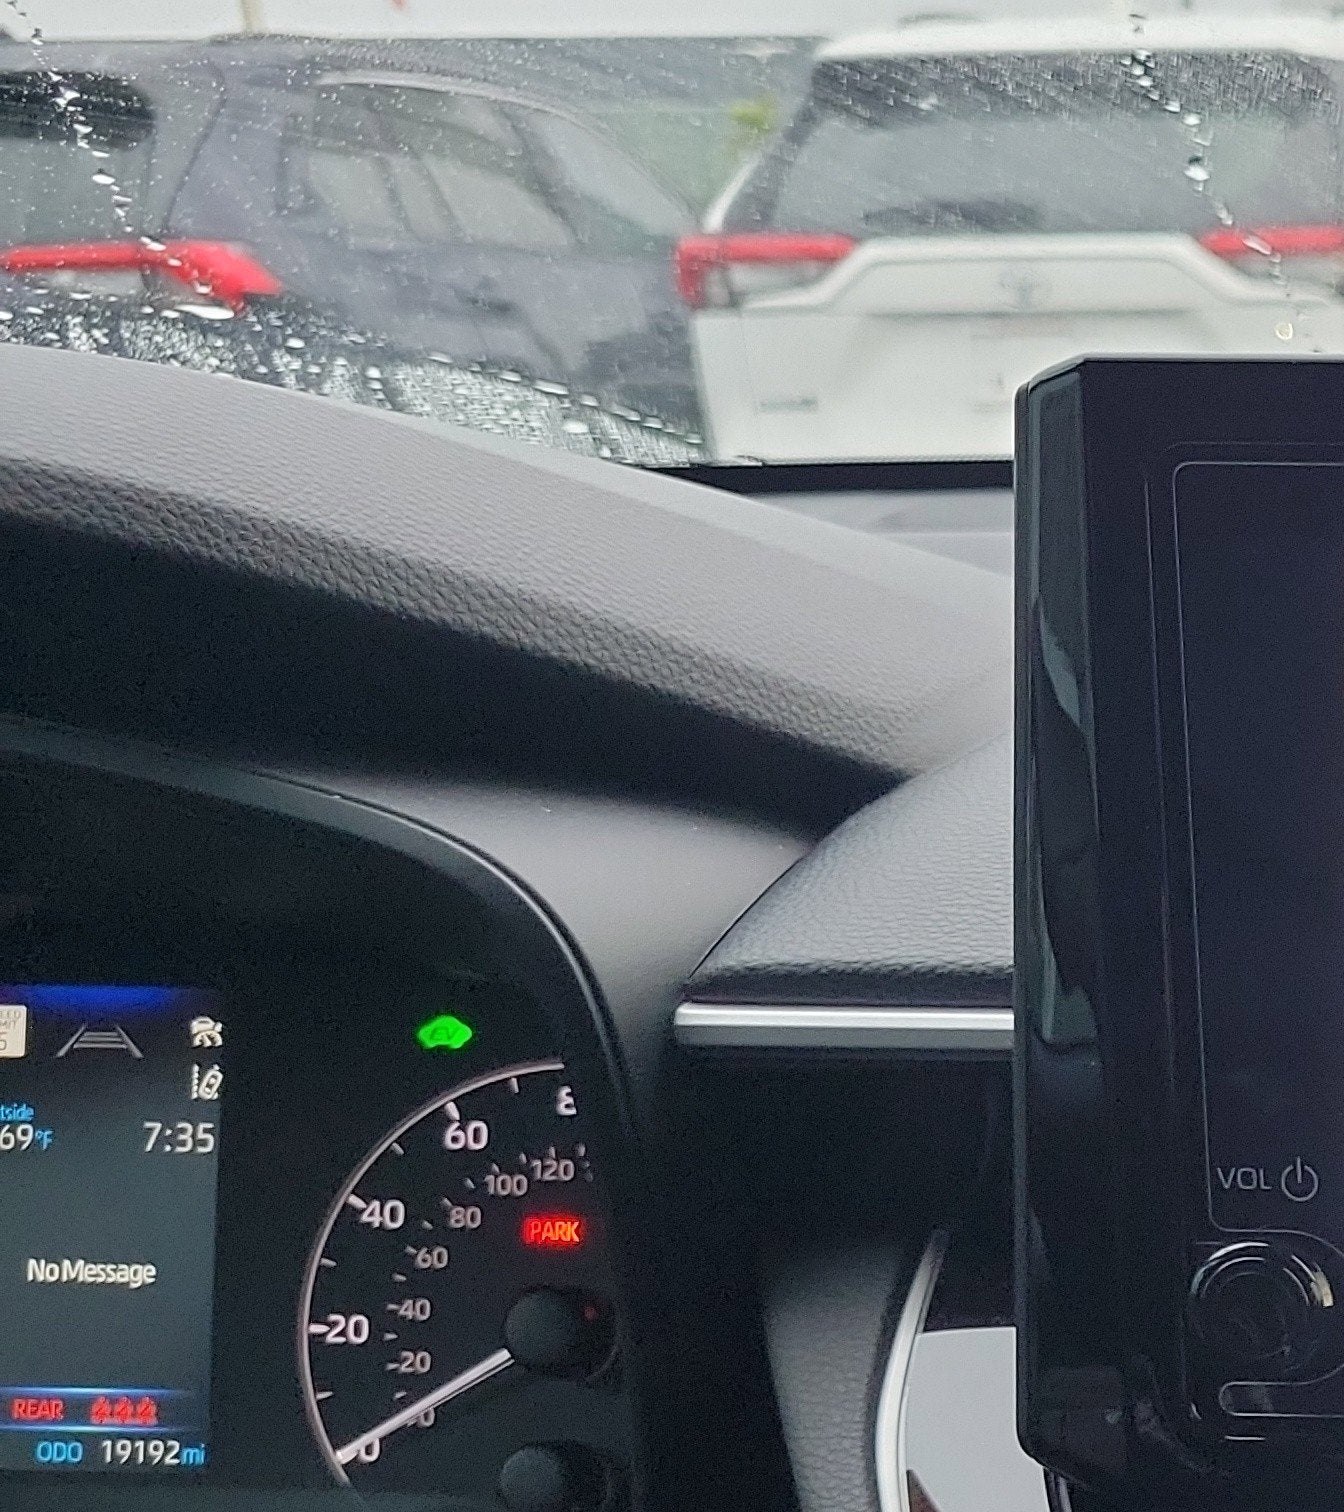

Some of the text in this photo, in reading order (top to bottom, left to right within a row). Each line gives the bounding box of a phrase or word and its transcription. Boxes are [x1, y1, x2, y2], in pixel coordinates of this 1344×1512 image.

[143, 1121, 215, 1153] 7:35
[443, 1119, 489, 1151] 60
[530, 1158, 576, 1182] 120
[1217, 1167, 1272, 1190] VOL
[484, 1174, 528, 1197] 100
[359, 1199, 405, 1230] 40
[449, 1206, 482, 1229] 80
[527, 1218, 581, 1244] PARK
[415, 1246, 449, 1269] 60
[27, 1258, 157, 1289] No Message
[399, 1298, 432, 1321] 40
[325, 1313, 370, 1345] 20
[399, 1350, 432, 1374] 20
[13, 1399, 65, 1421] REAR
[36, 1441, 83, 1463] ODO
